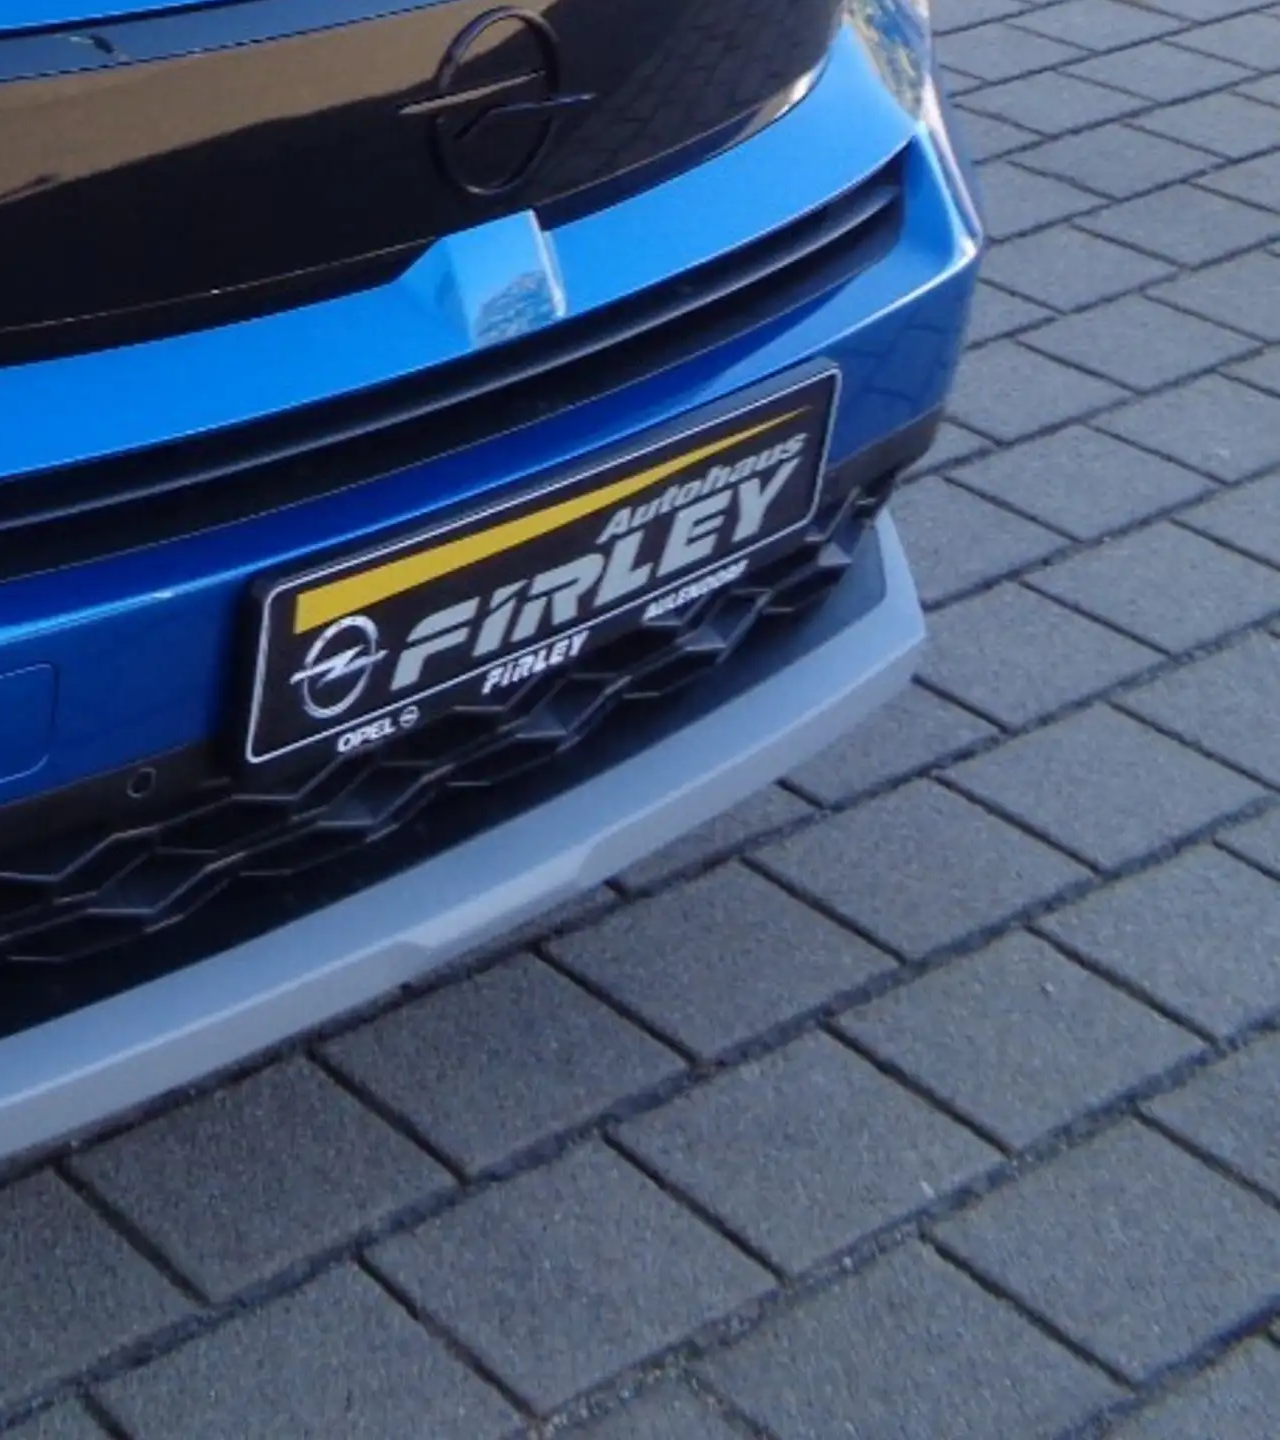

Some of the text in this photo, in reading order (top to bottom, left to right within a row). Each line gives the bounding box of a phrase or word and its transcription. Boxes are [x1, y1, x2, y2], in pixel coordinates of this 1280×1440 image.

[594, 432, 810, 545] Autohaus
[390, 455, 804, 692] FIRLEY
[337, 717, 396, 753] OPEL
[481, 629, 590, 696] FIRLEY
